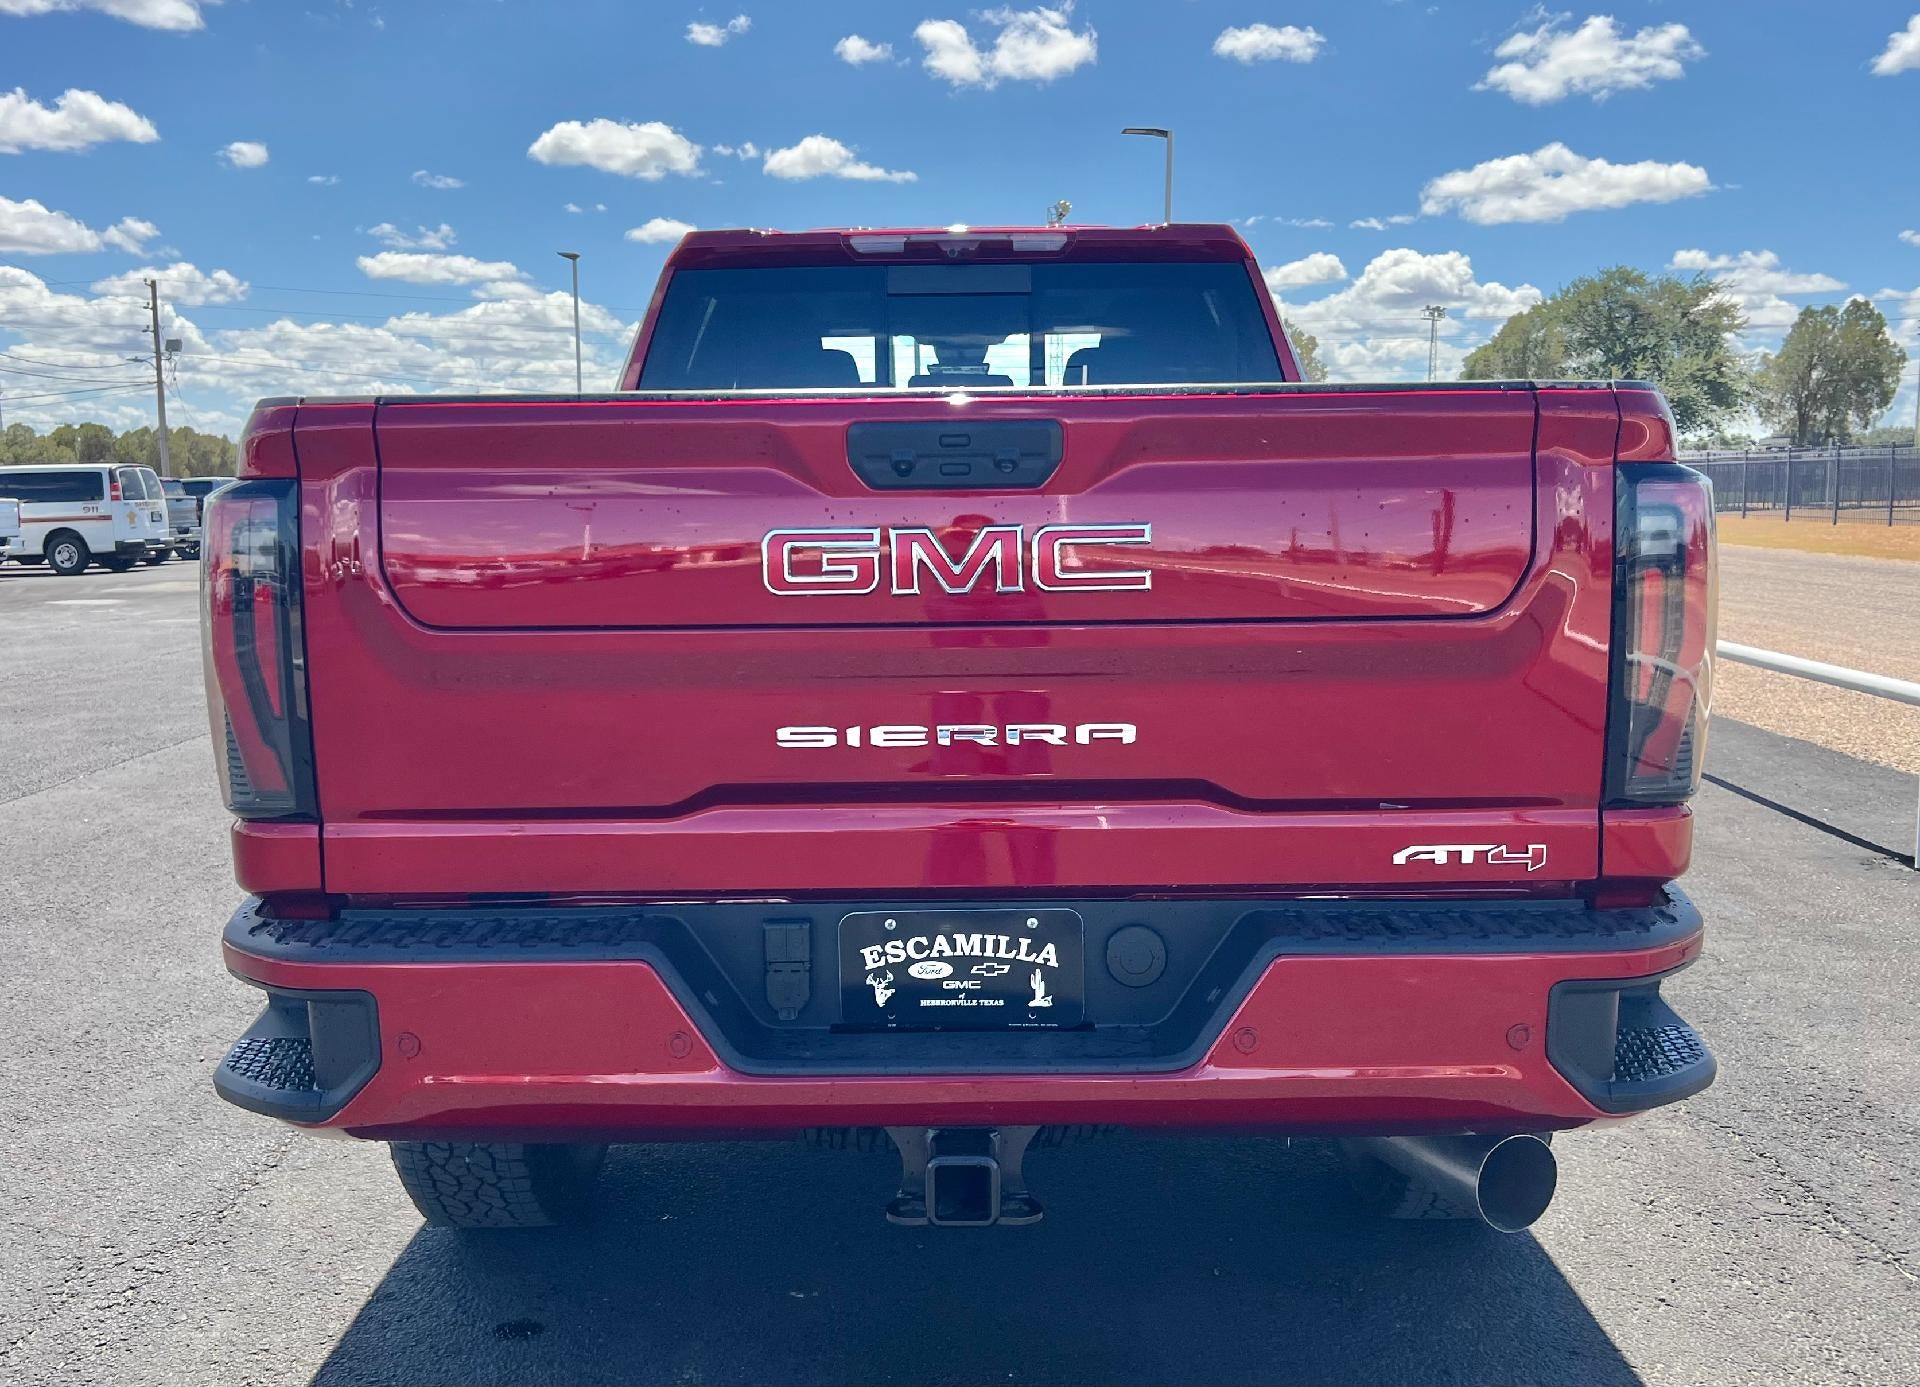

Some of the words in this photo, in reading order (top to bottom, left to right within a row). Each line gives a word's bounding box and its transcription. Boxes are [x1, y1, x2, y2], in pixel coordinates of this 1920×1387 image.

[82, 506, 99, 514] 911
[761, 523, 1153, 596] GMC
[776, 723, 1137, 748] SIERRA
[1392, 844, 1547, 872] AT4
[860, 933, 1059, 970] ESCAMILLA
[942, 980, 981, 989] GMC
[979, 999, 1005, 1007] TEXAS
